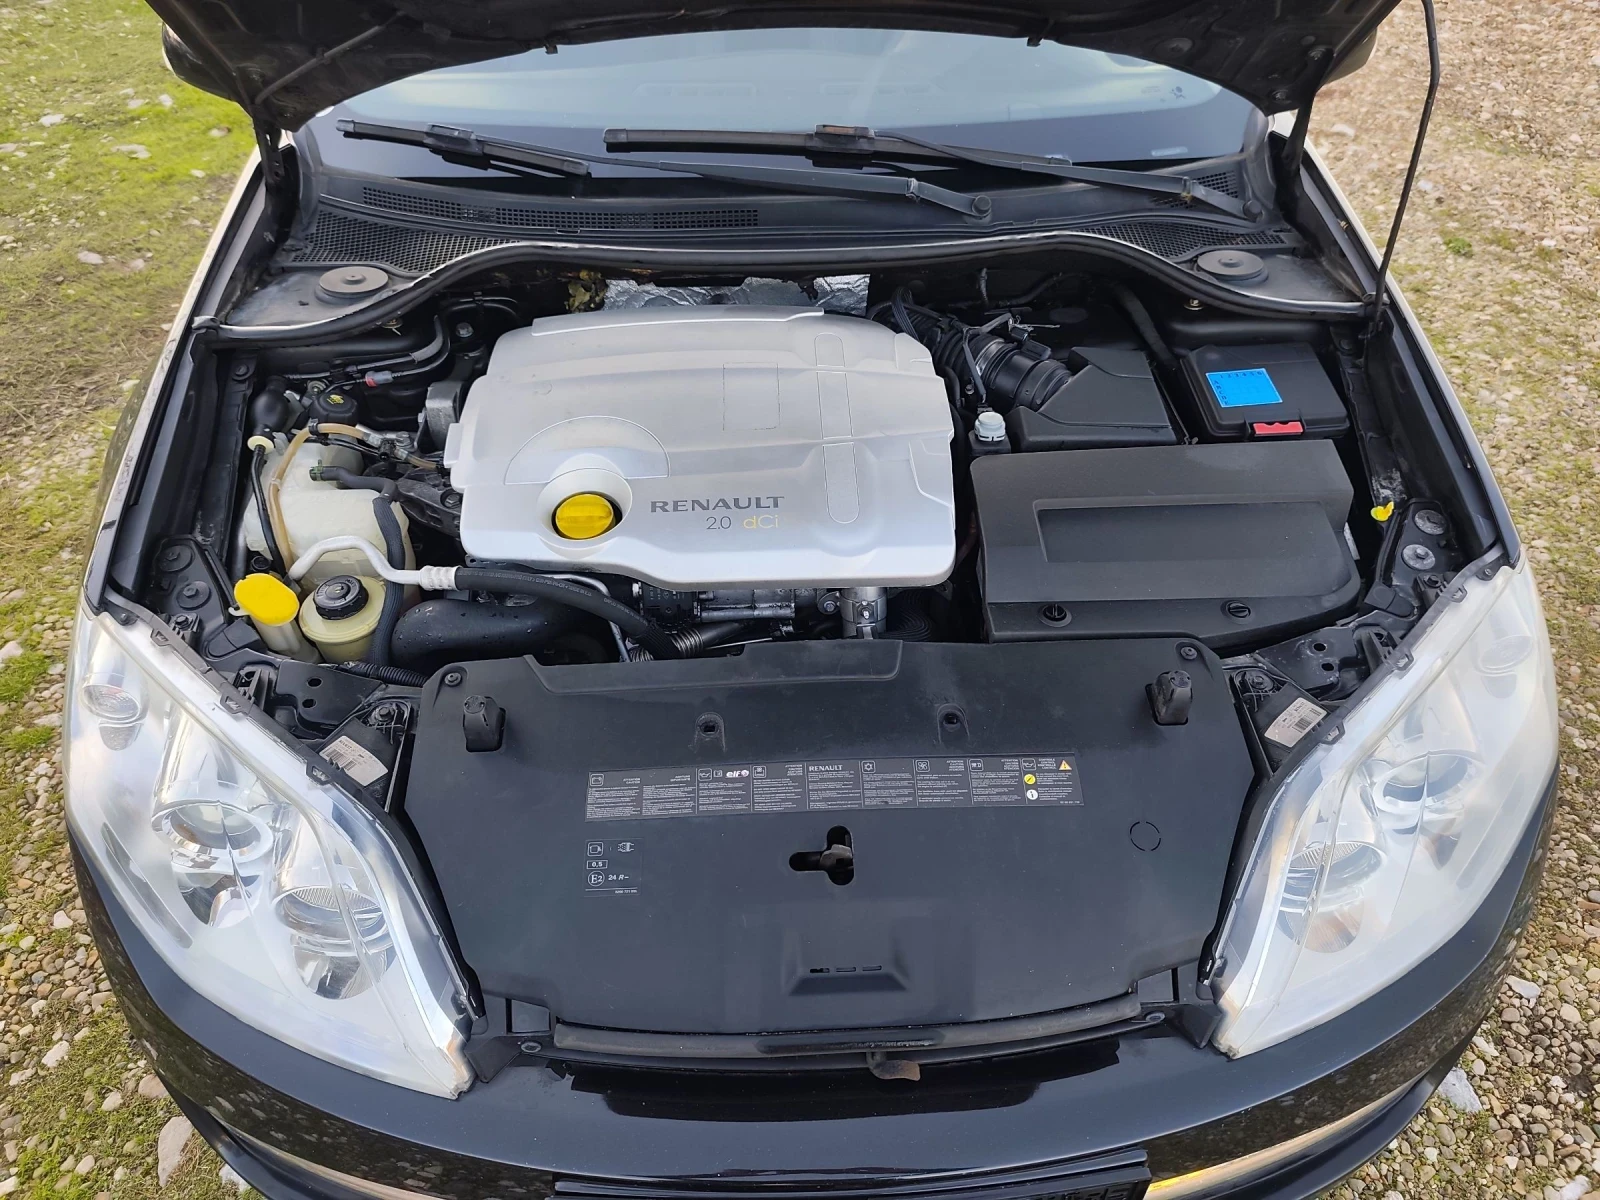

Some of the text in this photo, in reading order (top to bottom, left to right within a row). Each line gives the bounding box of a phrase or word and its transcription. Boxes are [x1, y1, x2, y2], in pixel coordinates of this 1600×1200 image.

[650, 496, 785, 513] RENAULT
[706, 514, 779, 530] 2.0 dCi
[591, 874, 603, 884] E2
